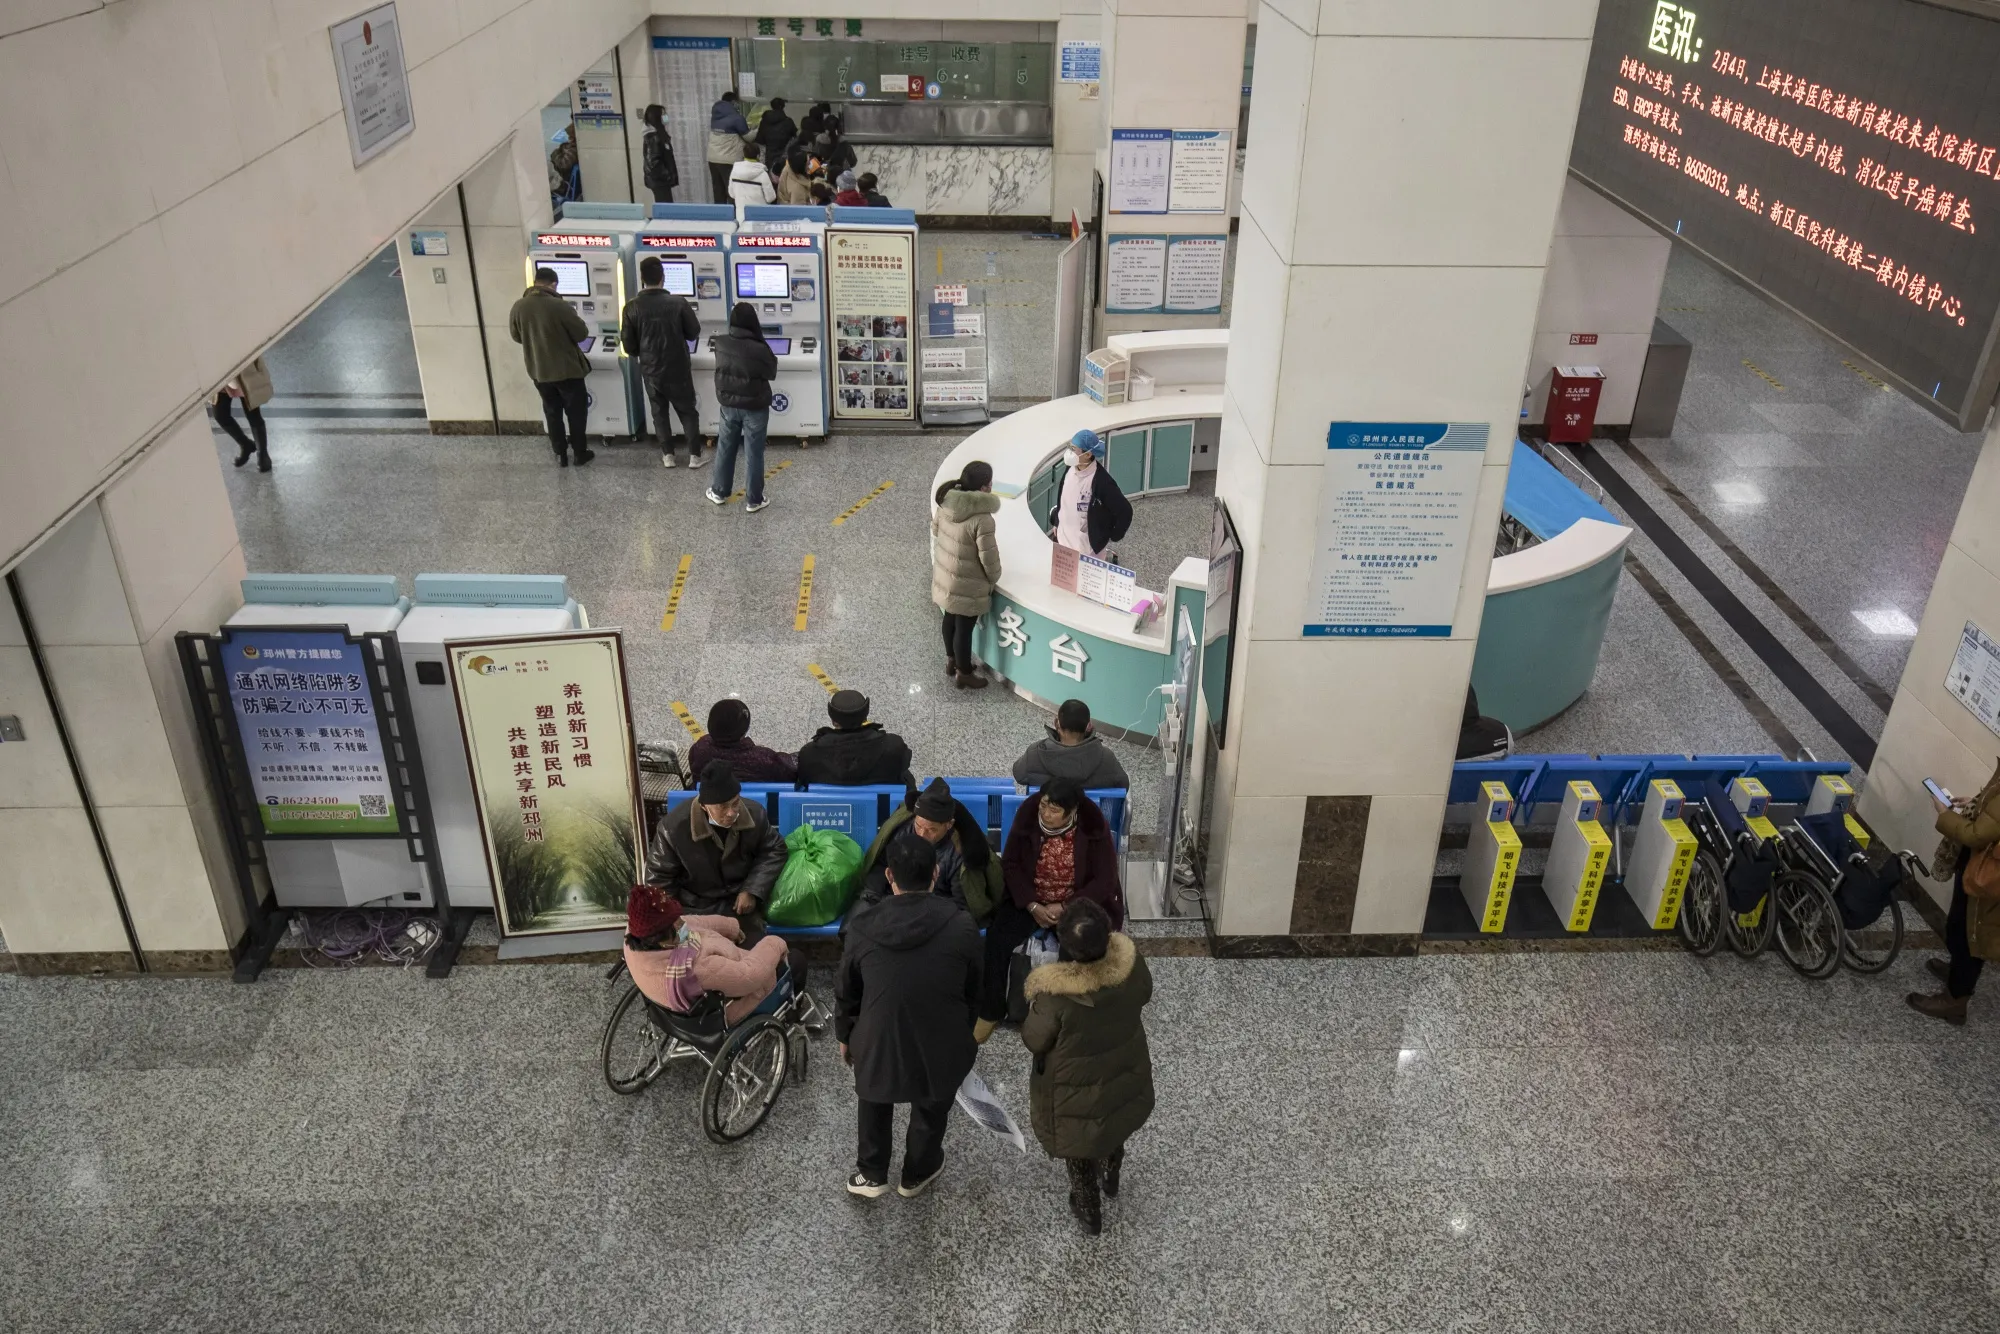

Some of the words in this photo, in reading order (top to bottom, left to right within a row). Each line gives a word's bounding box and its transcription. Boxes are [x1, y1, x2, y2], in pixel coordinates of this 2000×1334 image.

[1648, 0, 1703, 63] 医讯：
[901, 47, 929, 62] 挂号
[951, 47, 981, 62] 收费
[838, 68, 848, 82] 7
[937, 69, 949, 83] 6
[1017, 70, 1028, 84] 5
[1362, 435, 1425, 443] 邳州市人民医院
[1374, 453, 1430, 461] 公民道德规范
[1376, 481, 1415, 489] 医德规范
[976, 606, 1090, 682] 务台
[262, 649, 342, 660] 邳州警方提醒您
[236, 673, 362, 692] 通讯网络陷阱多
[242, 697, 369, 715] 防骗之心不可无
[258, 727, 365, 738] 给钱不要、要钱不给
[563, 683, 592, 768] 养成新习惯
[261, 742, 369, 752] 不听、不信、不转账
[534, 705, 566, 788] 塑造新民风
[507, 727, 544, 842] 共建共享新邳州
[282, 796, 338, 805] 86224500
[1489, 851, 1514, 927] 朗飞科技共享平台
[1575, 851, 1605, 926] 朗飞科技共享平台
[1661, 849, 1691, 924] 朗飞科技共享平台
